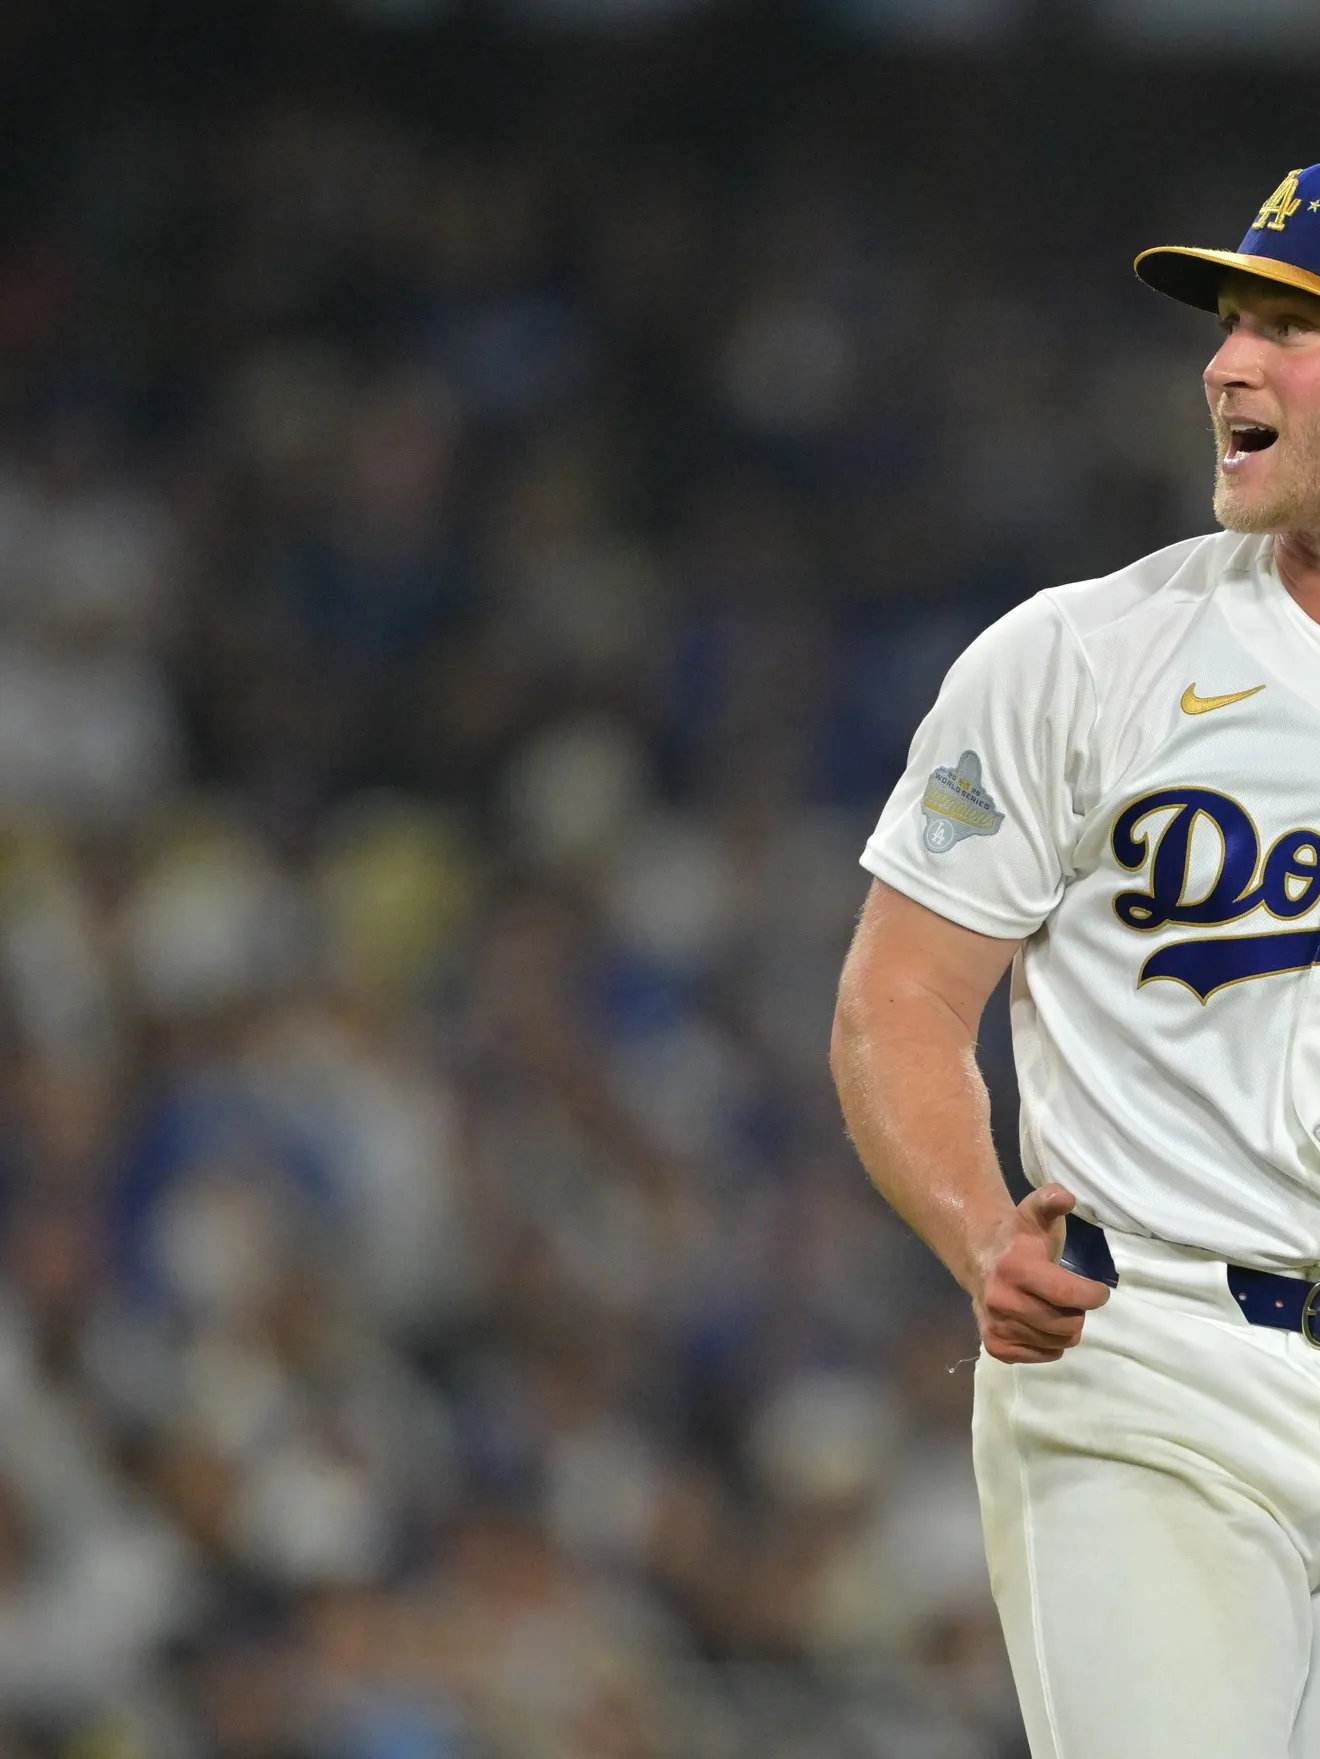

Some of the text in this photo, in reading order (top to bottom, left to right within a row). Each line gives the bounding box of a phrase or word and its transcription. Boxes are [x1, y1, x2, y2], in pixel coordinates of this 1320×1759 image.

[947, 771, 957, 781] 20
[934, 771, 991, 811] WORLD SERIES
[931, 821, 945, 845] LA
